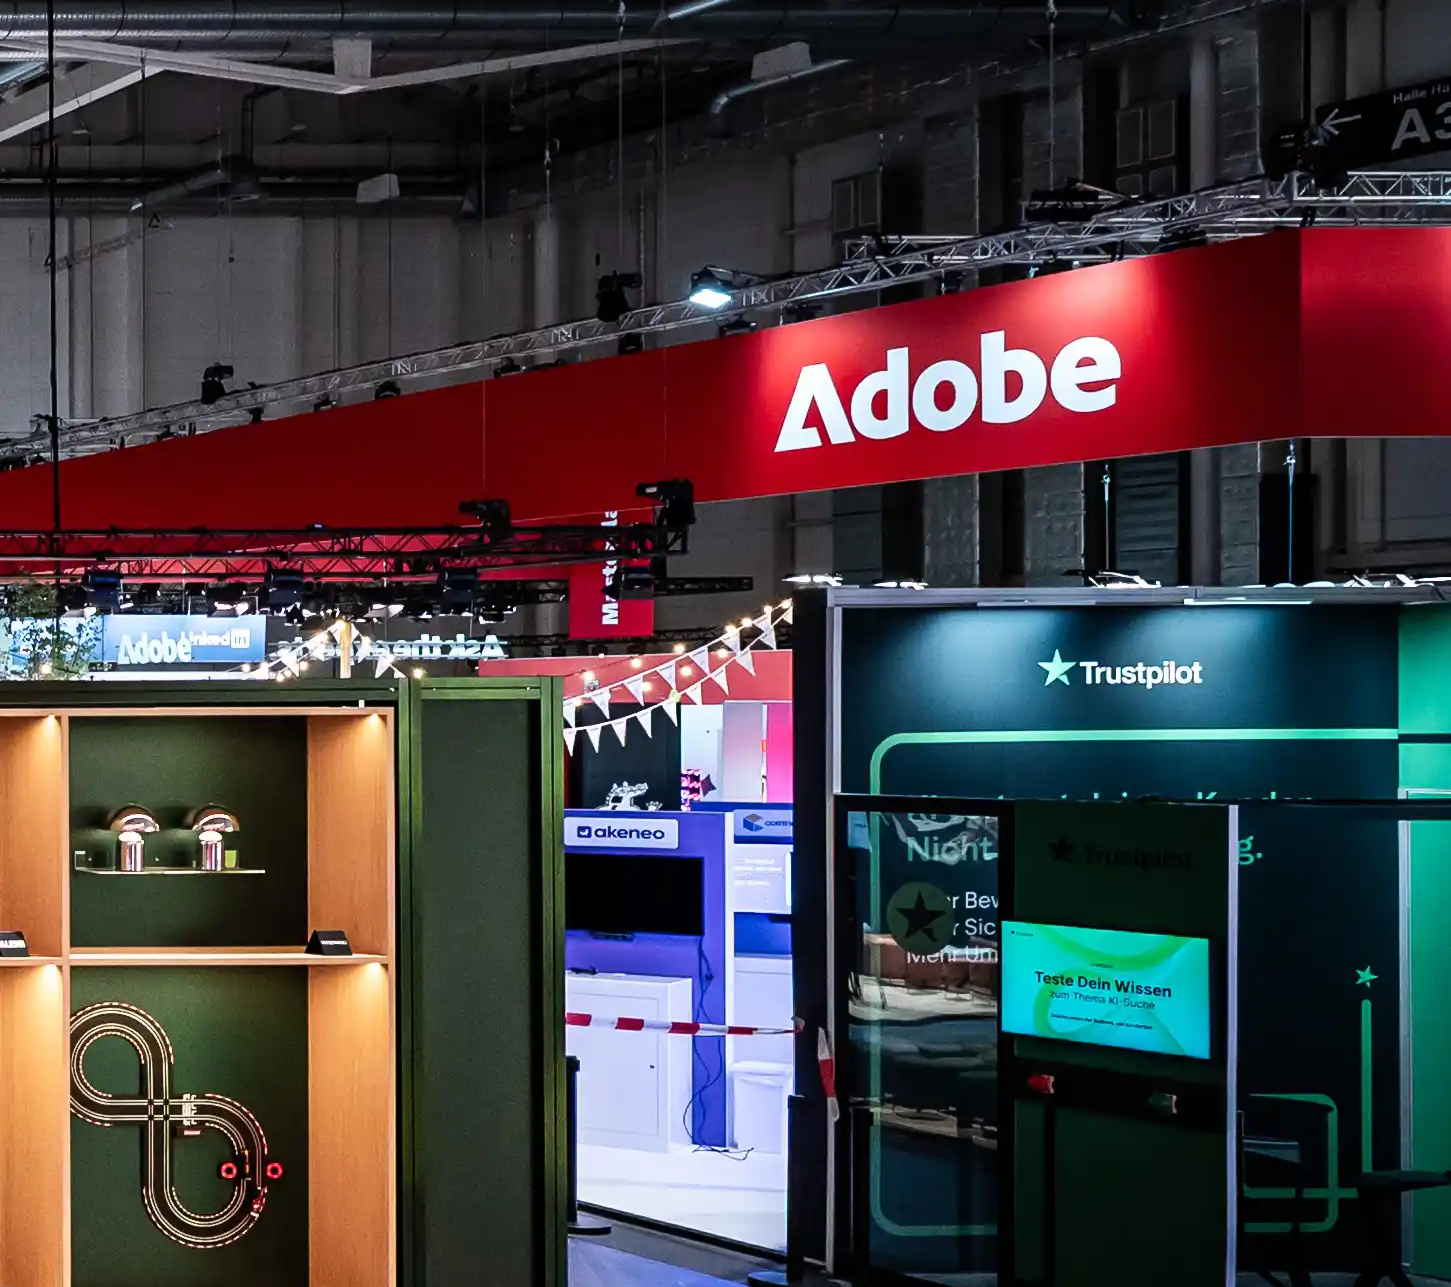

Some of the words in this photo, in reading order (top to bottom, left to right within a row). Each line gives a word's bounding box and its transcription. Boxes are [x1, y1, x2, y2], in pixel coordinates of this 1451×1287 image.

[773, 329, 1122, 454] Adobe
[117, 631, 192, 664] Adobe
[1079, 660, 1203, 690] Trustpilot
[594, 825, 666, 841] akeneo
[1035, 970, 1074, 987] Teste
[1078, 975, 1111, 991] Dein
[1115, 979, 1172, 998] Wissen
[1049, 991, 1070, 1000] zum
[1073, 992, 1106, 1004] Thema
[1109, 997, 1156, 1010] KI-Suche
